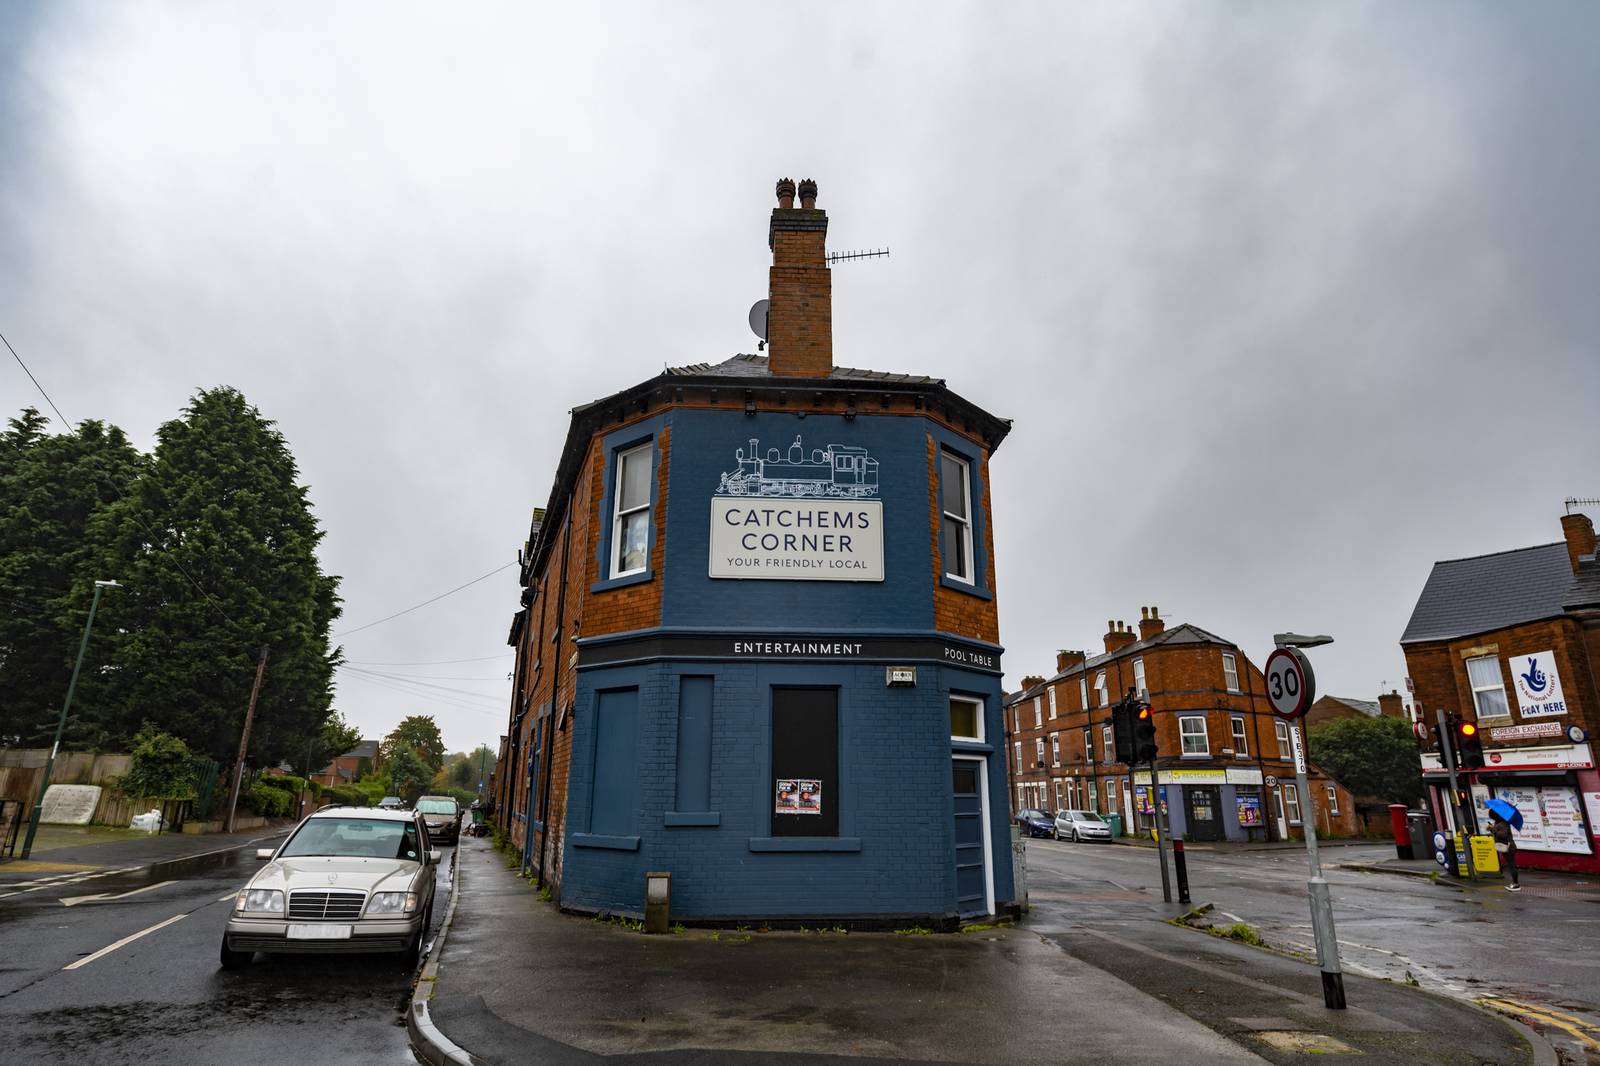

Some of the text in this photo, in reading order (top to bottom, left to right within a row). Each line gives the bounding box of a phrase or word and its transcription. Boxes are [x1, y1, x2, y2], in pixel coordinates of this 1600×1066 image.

[725, 508, 870, 529] CATCHEMS
[741, 533, 853, 552] CORNER
[727, 558, 868, 569] YOUR FRIENDLY LOCAL
[734, 642, 863, 655] ENTERTAINMENT
[944, 647, 992, 667] POOL TABLE
[1269, 667, 1299, 700] 30
[1543, 701, 1566, 713] HERE
[1491, 727, 1521, 737] FOREIGN
[1522, 722, 1561, 734] EXCHANGE
